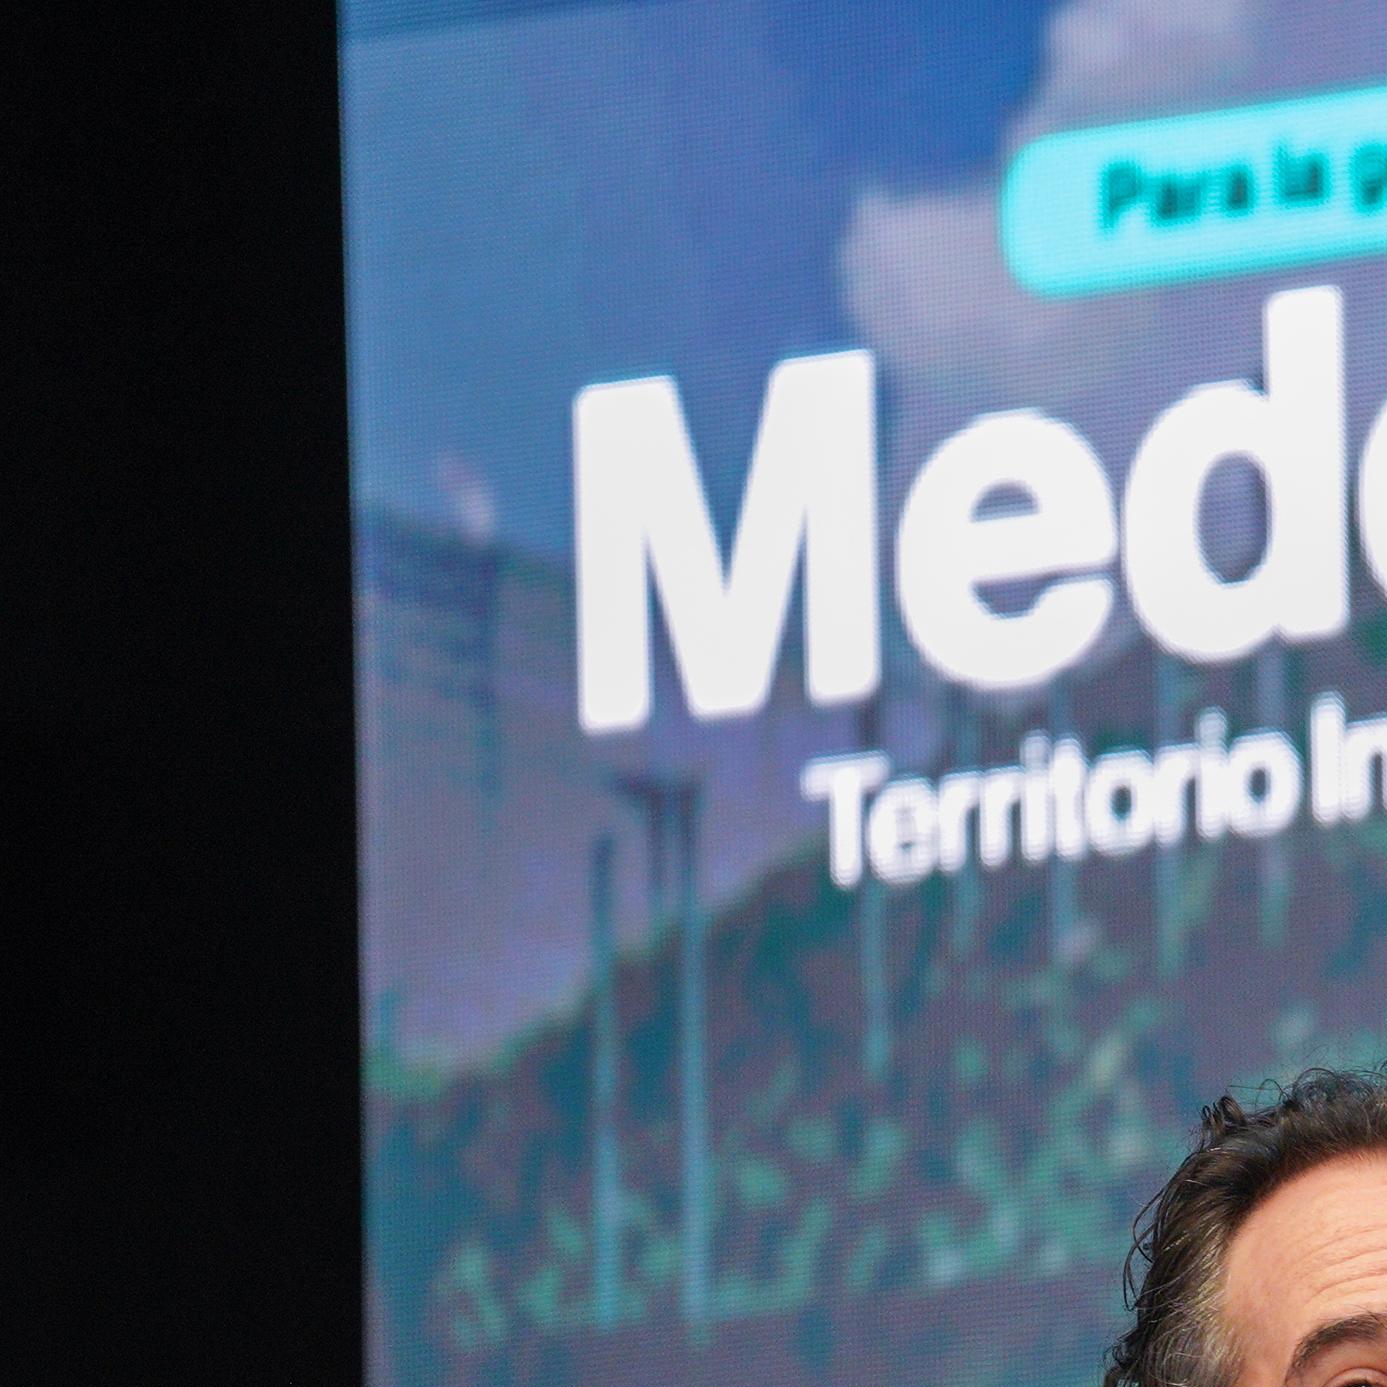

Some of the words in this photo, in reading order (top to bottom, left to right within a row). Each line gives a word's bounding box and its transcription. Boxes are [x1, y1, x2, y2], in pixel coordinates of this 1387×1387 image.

[1100, 161, 1253, 233] Para
[1276, 143, 1331, 204] la
[802, 707, 1302, 886] Territorio
